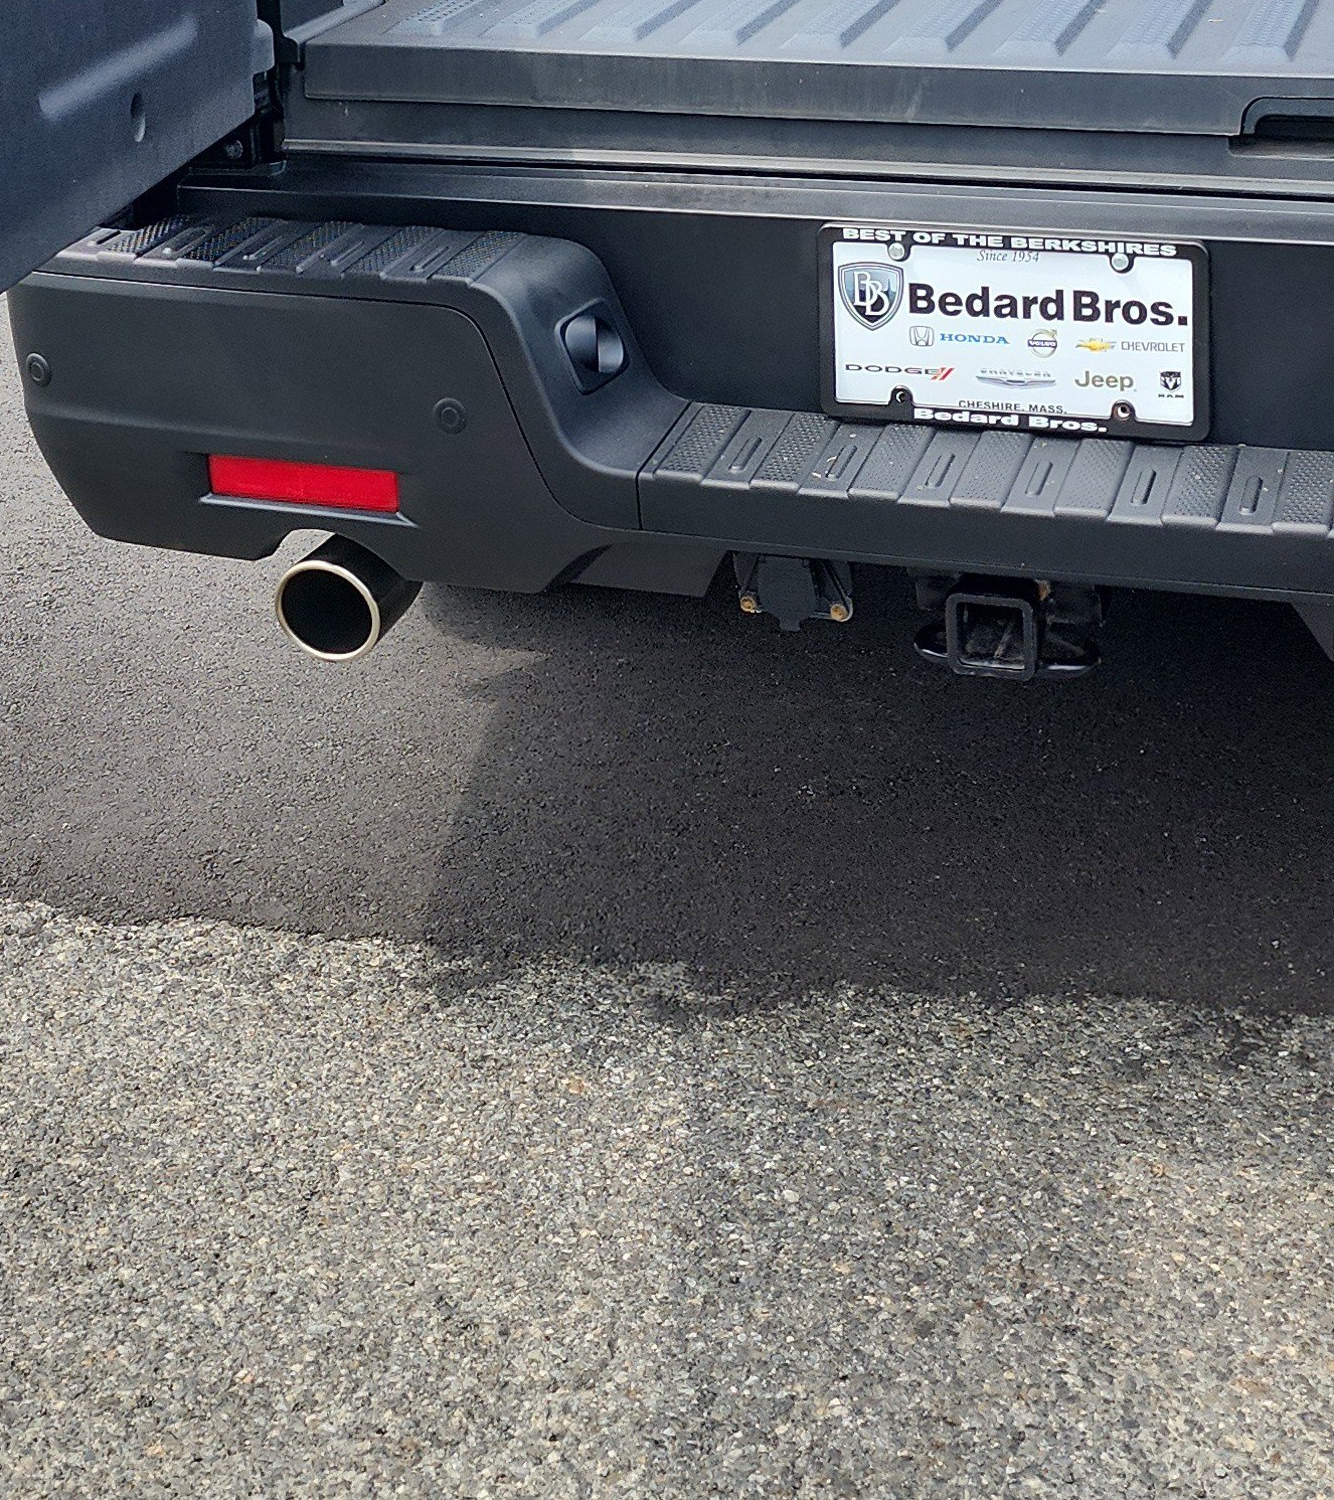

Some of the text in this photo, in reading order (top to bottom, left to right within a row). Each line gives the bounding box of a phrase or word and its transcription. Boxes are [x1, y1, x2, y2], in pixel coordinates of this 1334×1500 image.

[842, 227, 1177, 257] BEST OF THE BERKSHIRES
[976, 250, 1040, 263] Since 1954
[908, 282, 1189, 326] Bedard Bros.
[940, 333, 1010, 345] HONDA
[1121, 341, 1186, 353] CHEVROLET
[845, 364, 940, 375] DODGE
[1074, 370, 1135, 392] Jeep
[913, 408, 1107, 433] Bedard Bros.
